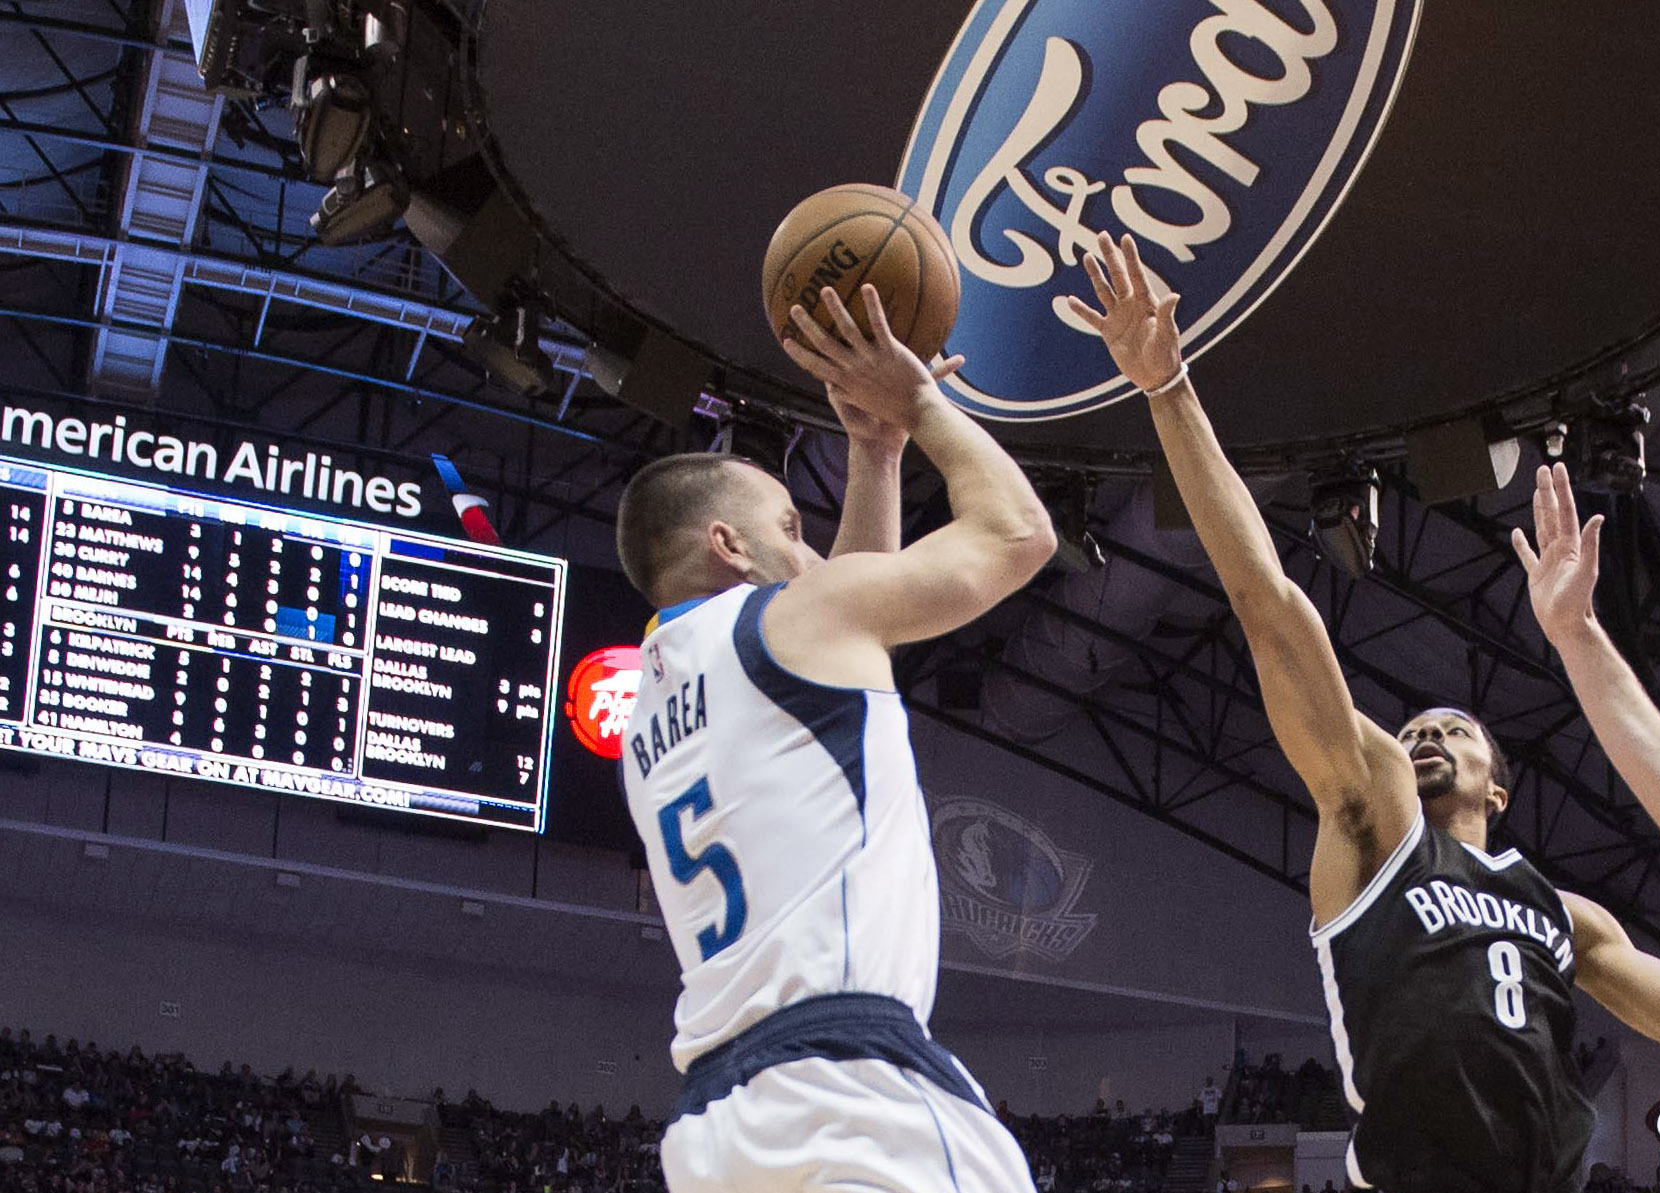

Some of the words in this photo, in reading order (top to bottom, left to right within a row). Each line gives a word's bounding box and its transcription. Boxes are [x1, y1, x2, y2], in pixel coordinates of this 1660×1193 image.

[223, 441, 421, 518] Airlines
[78, 525, 164, 553] MATTHEWS
[78, 545, 130, 567] CURRY
[75, 566, 137, 590] BARNES
[381, 574, 429, 598] SCORE
[51, 605, 137, 633] BROOKLYN
[166, 625, 194, 642] PTS
[249, 639, 278, 656] AST
[379, 601, 416, 622] LEAD
[418, 608, 488, 634] CHANGES
[375, 634, 438, 660] LARGEST
[440, 646, 476, 665] LEAD
[373, 658, 428, 680] DALLAS
[372, 673, 452, 699] BROOKLYN
[60, 713, 143, 740] HAMILTON
[368, 711, 455, 739] TURNOVERS
[630, 673, 707, 780] BAREA
[19, 731, 75, 755] YOUR
[79, 741, 138, 765] MAVS
[141, 749, 193, 774] GEAR
[197, 760, 230, 779] ON
[232, 766, 259, 784] AT
[365, 744, 446, 770] BROOKLYN
[367, 730, 422, 752] DALLAS
[517, 755, 534, 771] 12
[658, 773, 748, 962] 5
[1405, 880, 1573, 972] BROOKLYN
[1488, 941, 1526, 1028] 8
